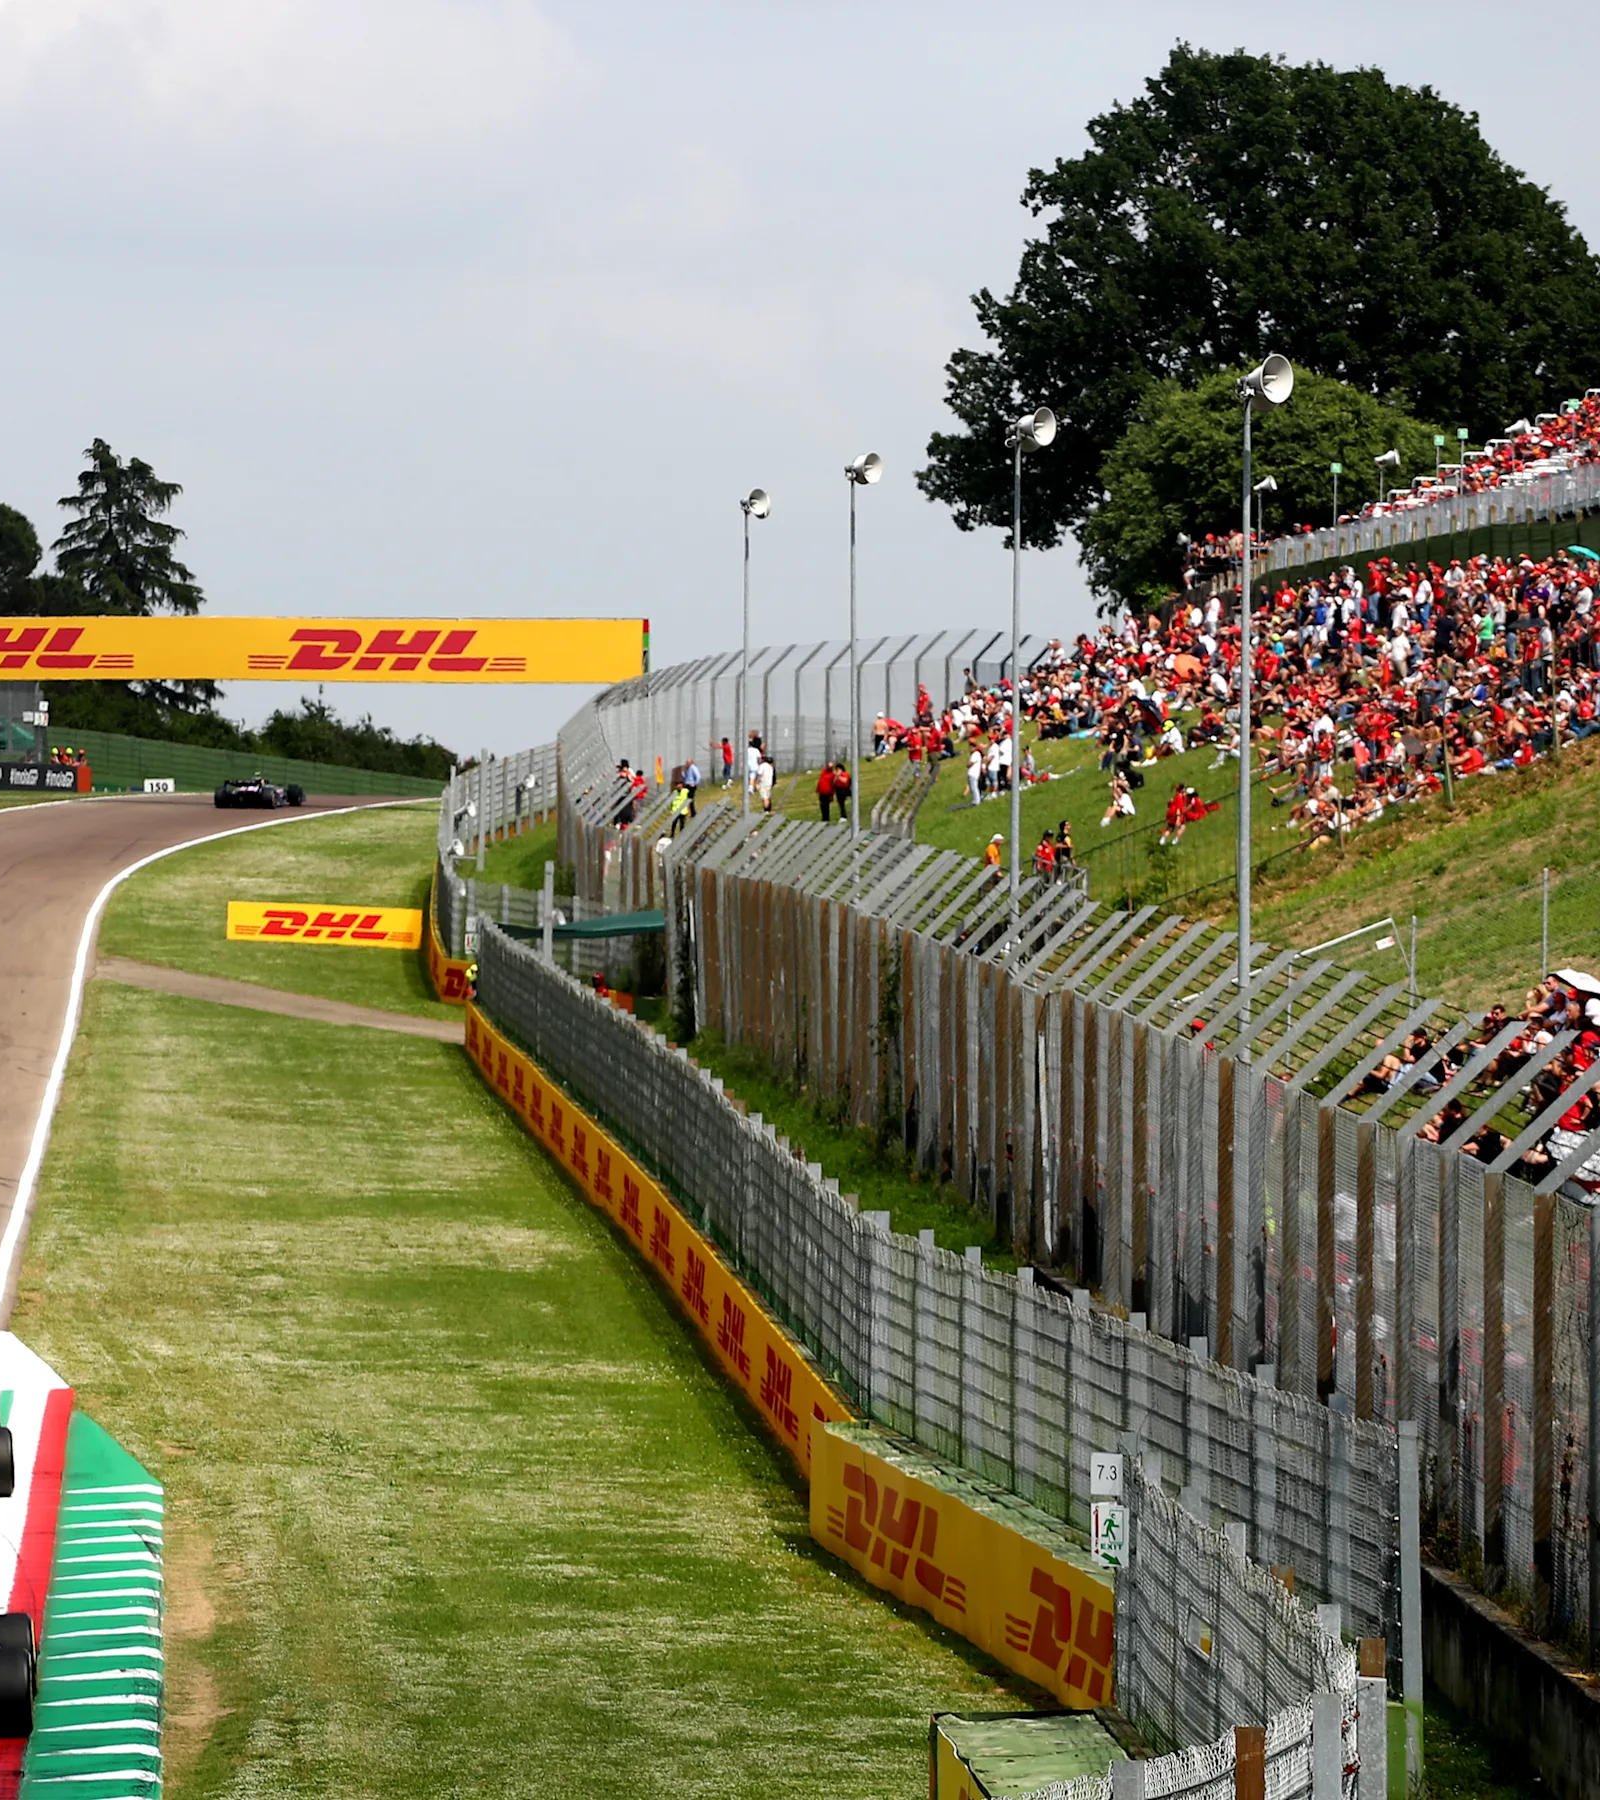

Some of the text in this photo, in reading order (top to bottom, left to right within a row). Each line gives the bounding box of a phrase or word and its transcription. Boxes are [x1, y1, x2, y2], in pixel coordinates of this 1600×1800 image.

[288, 629, 487, 671] DHL
[149, 782, 169, 793] 150
[259, 910, 389, 940] DHL
[765, 1343, 795, 1436] DHL
[1096, 1464, 1117, 1481] 7.3
[842, 1462, 946, 1601] DHL
[1028, 1566, 1116, 1704] DH
